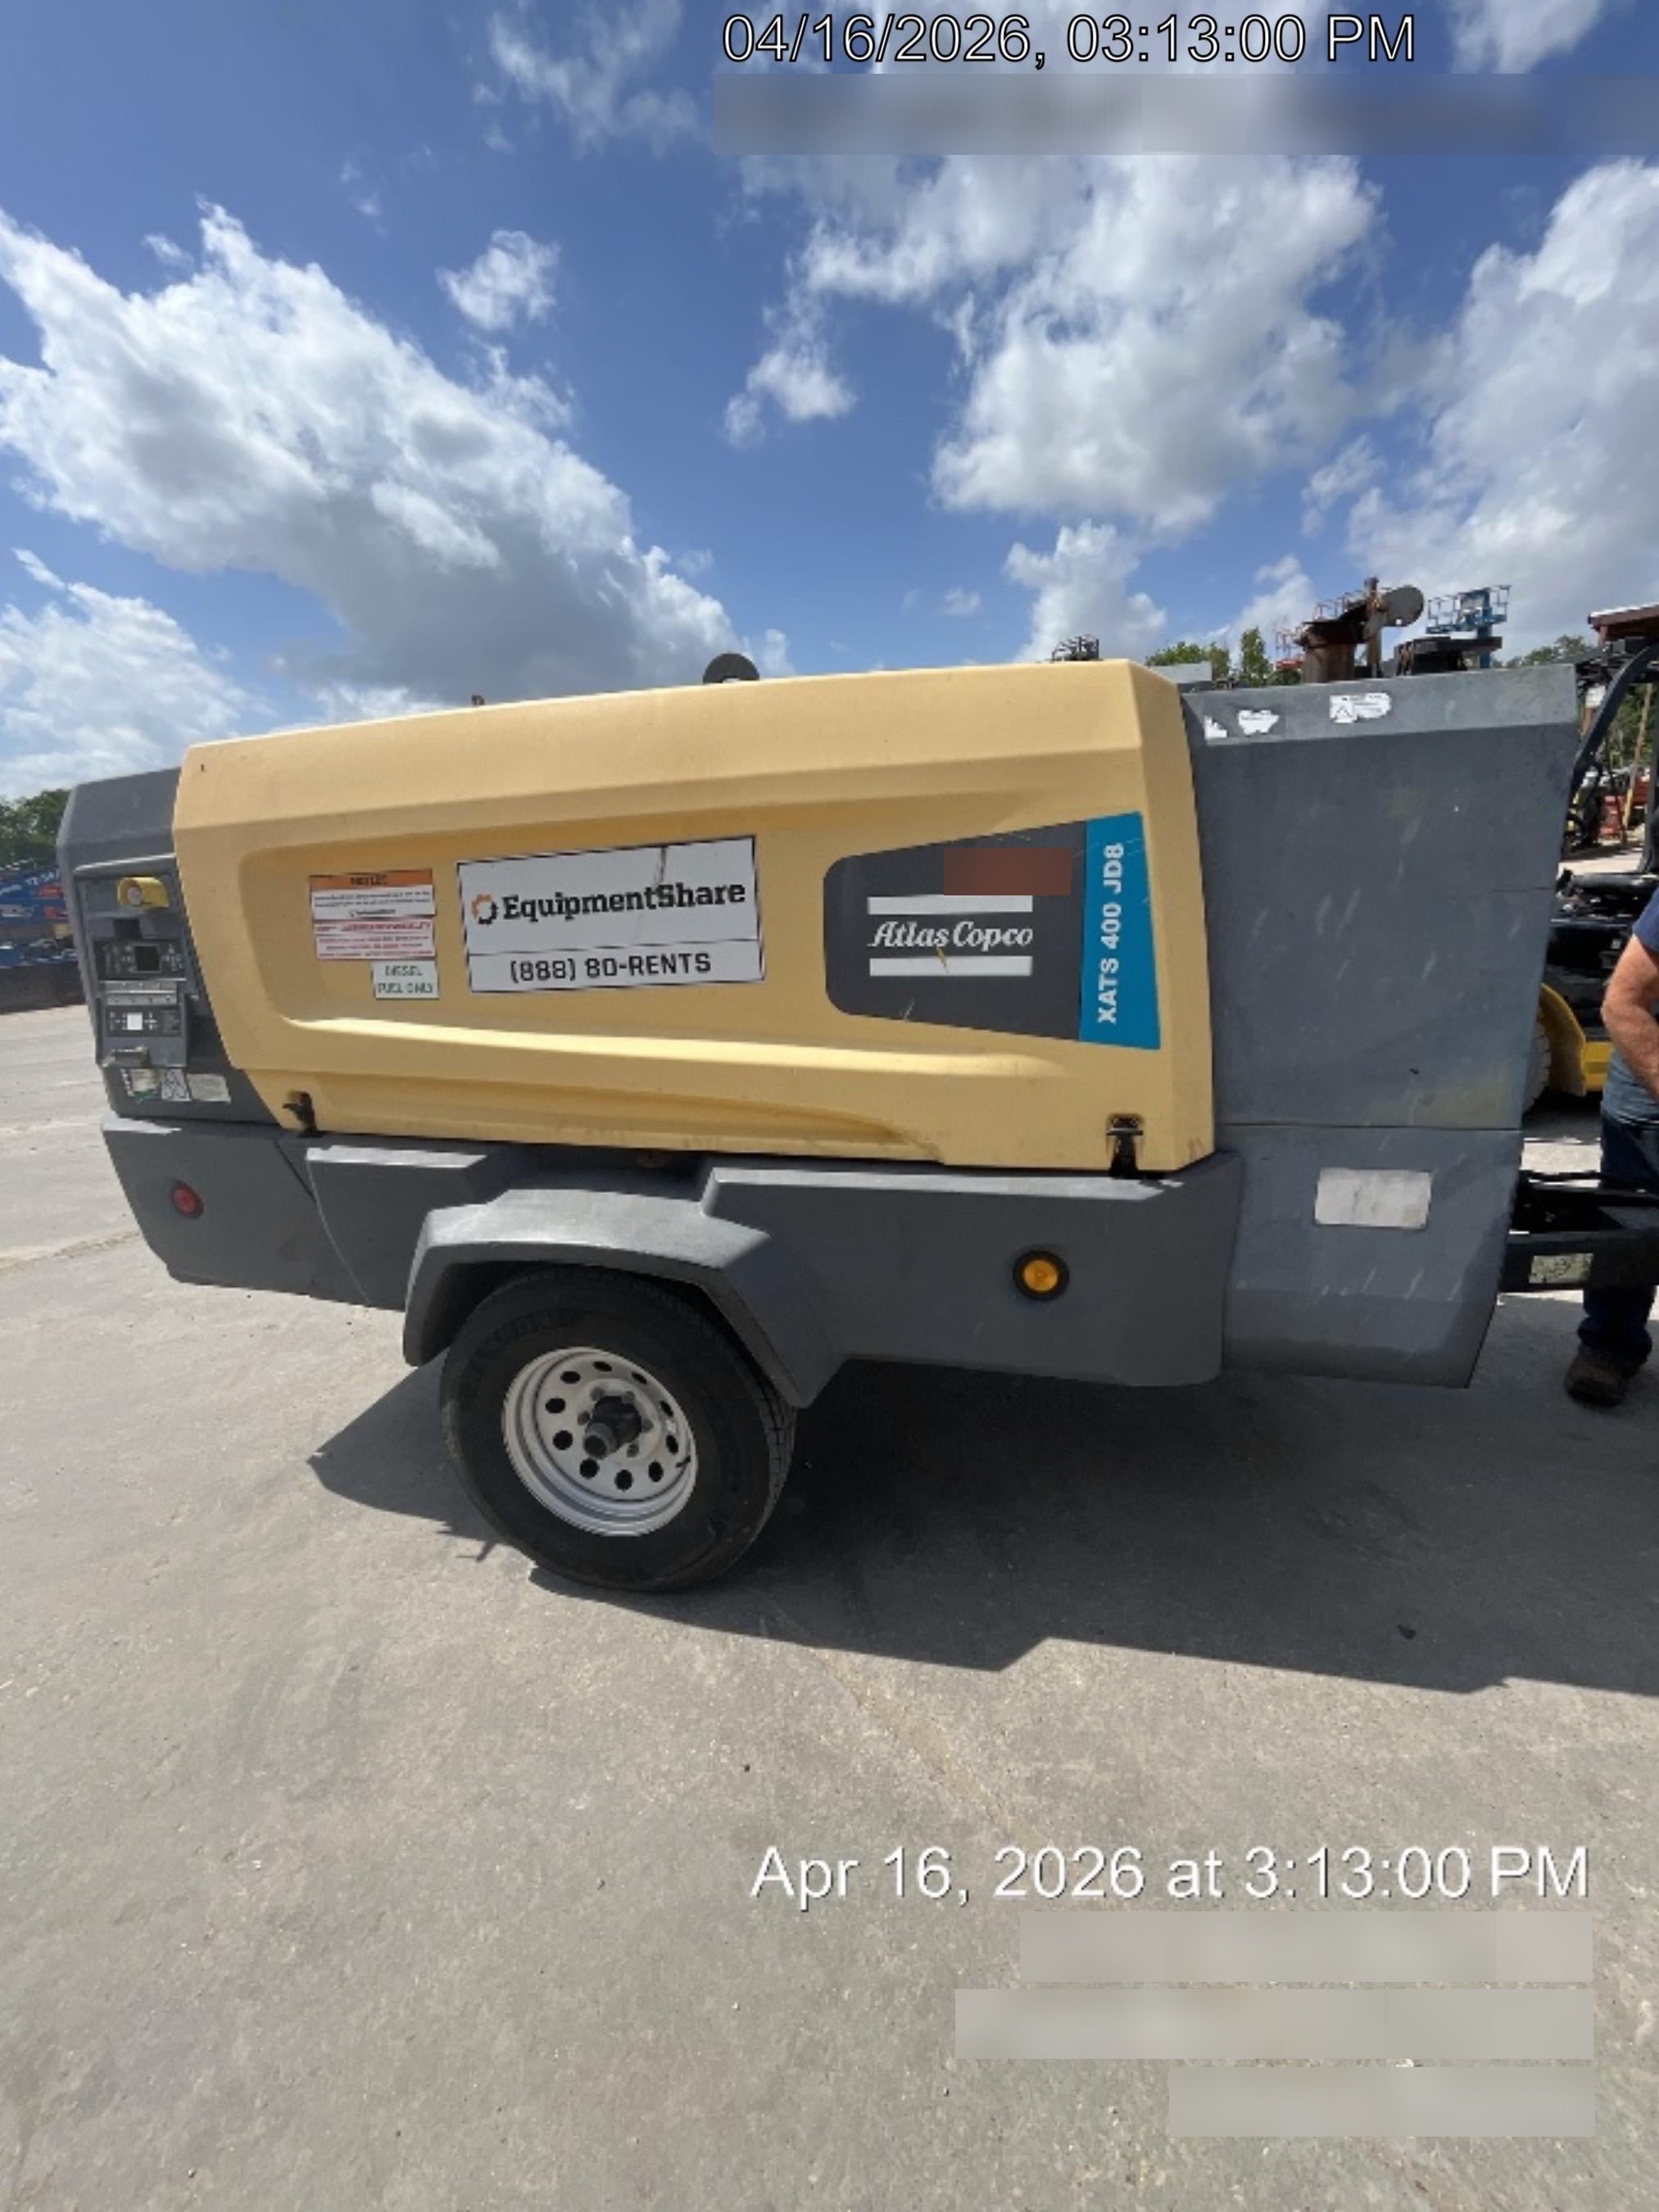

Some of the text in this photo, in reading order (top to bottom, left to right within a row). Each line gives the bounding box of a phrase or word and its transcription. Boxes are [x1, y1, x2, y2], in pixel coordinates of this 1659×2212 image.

[502, 882, 746, 922] EquipmentShare
[868, 921, 1033, 952] Atlas Copco
[1098, 843, 1125, 1024] XATS 400 JD8
[510, 952, 712, 983] (888) 80-RENTS
